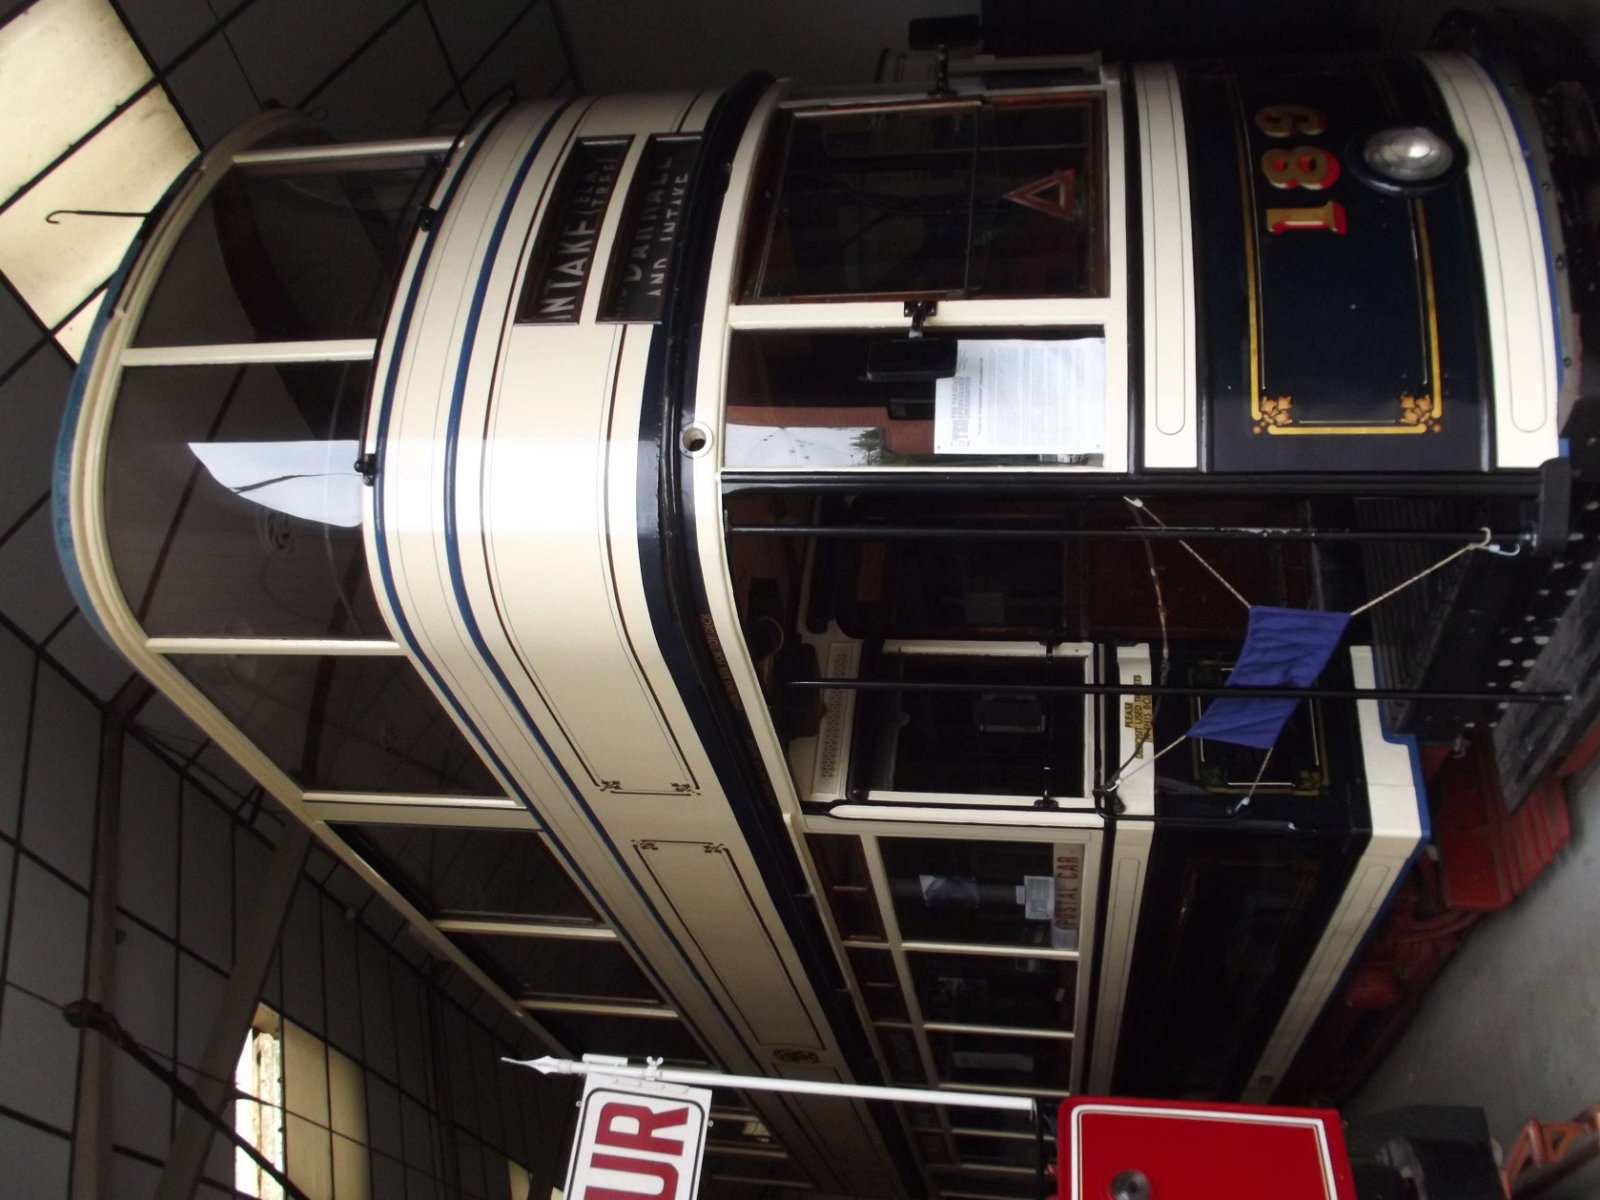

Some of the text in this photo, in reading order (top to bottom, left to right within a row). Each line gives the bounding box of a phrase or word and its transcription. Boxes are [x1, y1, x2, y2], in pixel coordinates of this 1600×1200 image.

[1251, 103, 1348, 236] 189
[538, 220, 596, 320] INTAKE
[646, 172, 689, 296] AND INTAKE
[1124, 702, 1134, 728] PLEASE
[1134, 705, 1143, 724] USED
[1055, 856, 1078, 927] POSTAL CAR
[583, 1102, 689, 1200] UR
